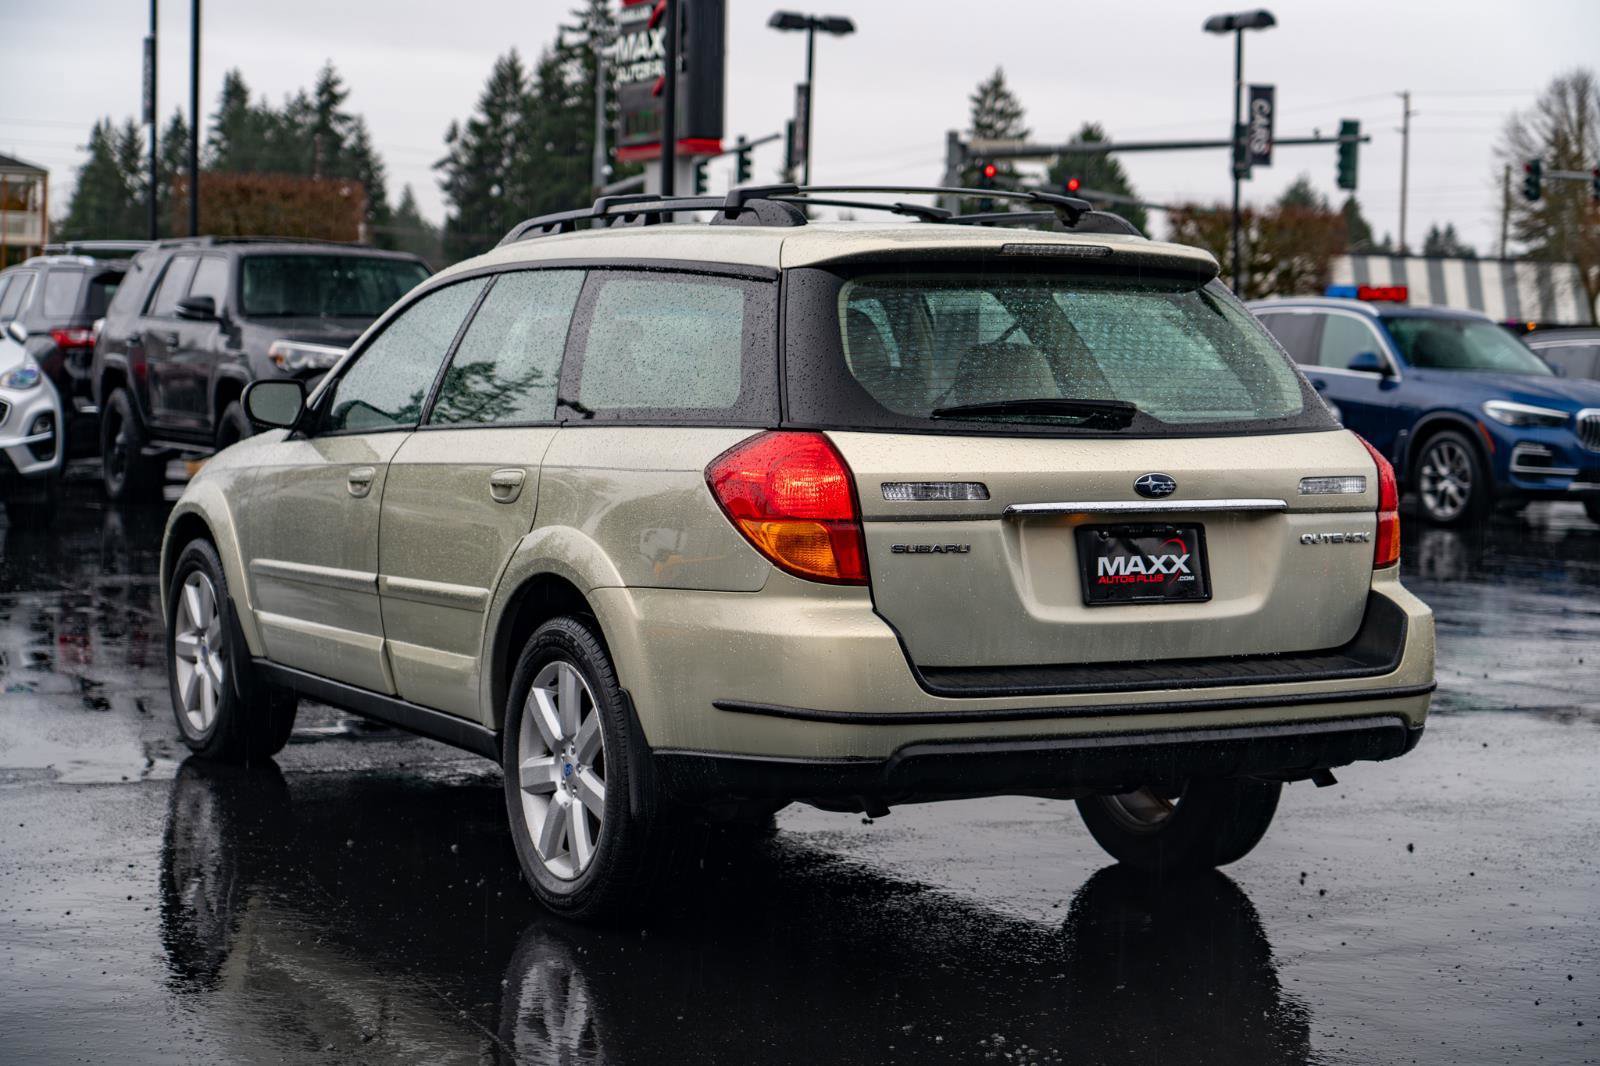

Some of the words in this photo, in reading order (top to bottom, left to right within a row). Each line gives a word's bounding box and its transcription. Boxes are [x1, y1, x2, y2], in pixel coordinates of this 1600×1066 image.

[615, 27, 667, 63] MAX
[1300, 531, 1370, 545] OUTBACK
[890, 543, 971, 553] SUBARU
[1097, 553, 1191, 576] MAXX
[1098, 575, 1135, 585] AUTOS
[1136, 573, 1165, 584] PLUS
